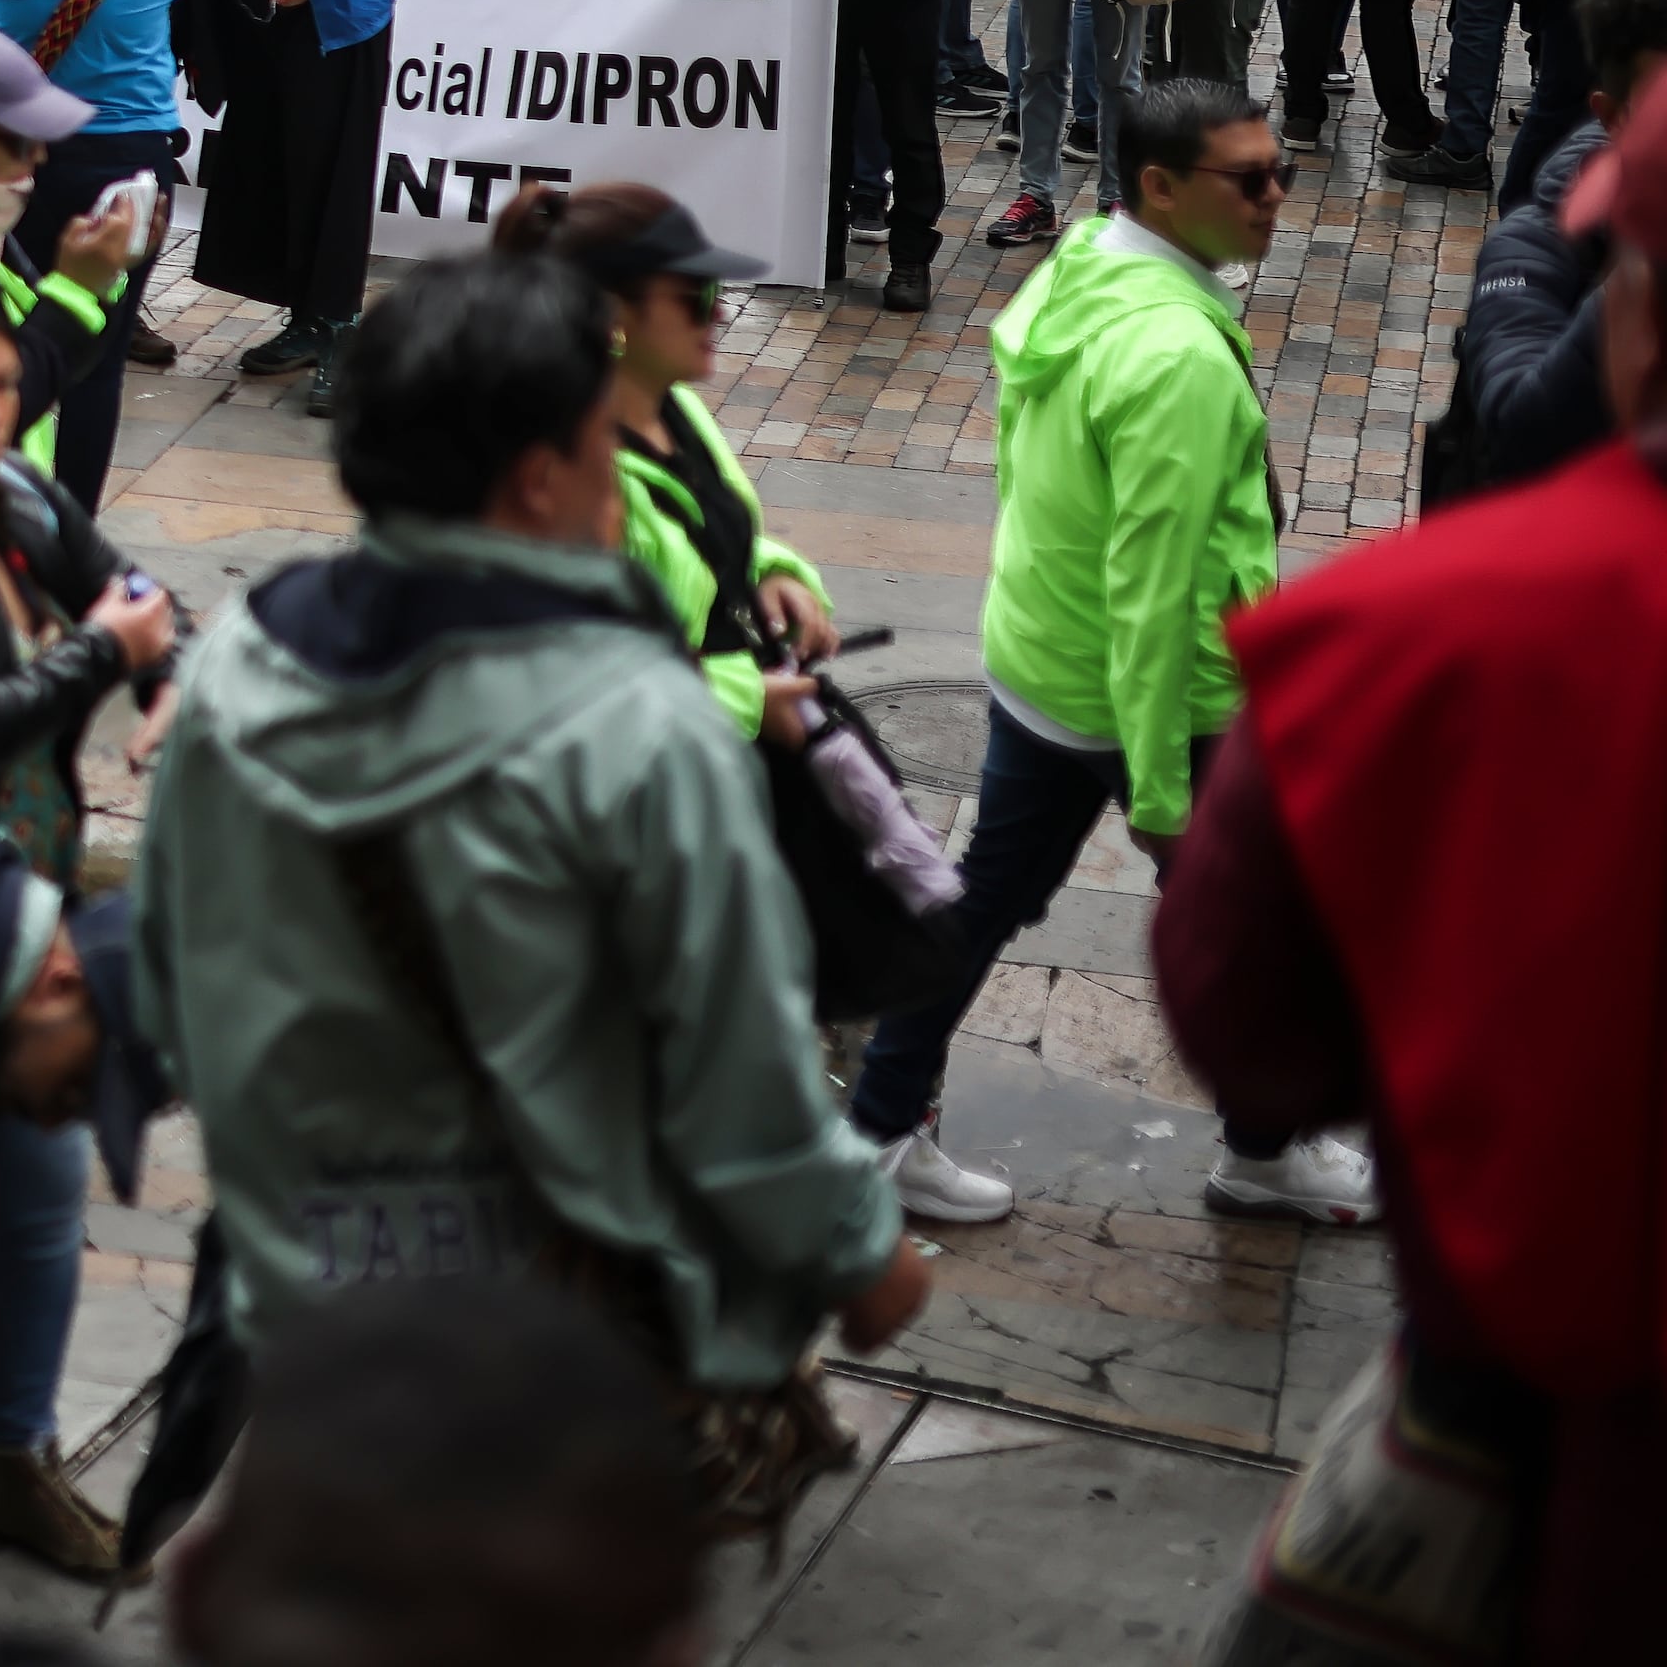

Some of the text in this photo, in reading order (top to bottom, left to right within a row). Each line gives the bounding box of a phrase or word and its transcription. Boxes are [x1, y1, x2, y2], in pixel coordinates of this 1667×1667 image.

[384, 43, 781, 131] cial IDIPRON
[1480, 276, 1527, 296] PRENSA
